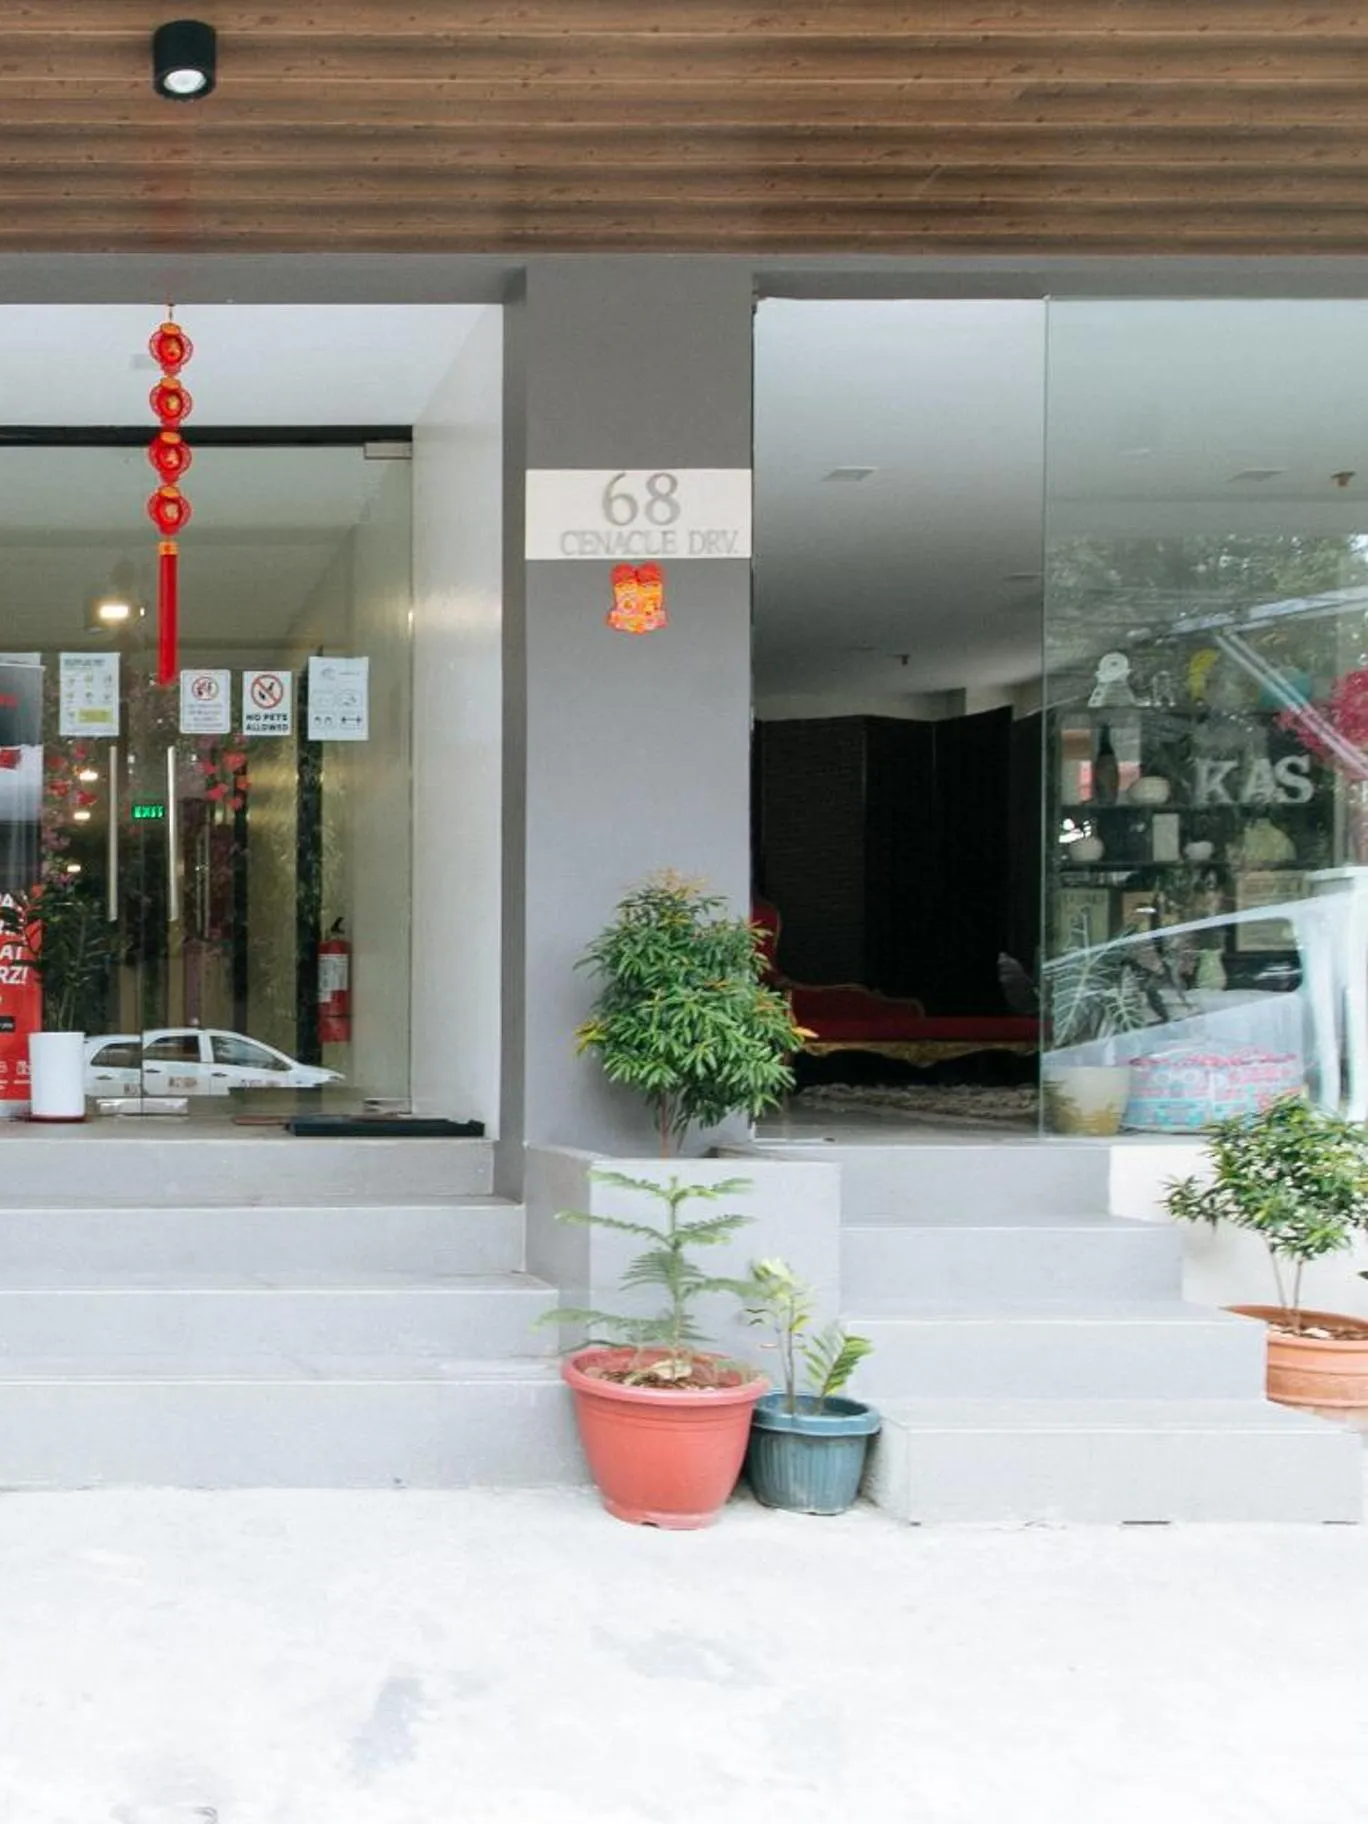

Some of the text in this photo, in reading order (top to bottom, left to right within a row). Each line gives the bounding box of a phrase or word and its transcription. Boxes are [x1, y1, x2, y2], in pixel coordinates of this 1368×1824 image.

[602, 472, 681, 526] 68
[560, 530, 677, 556] CENACLE
[246, 713, 288, 721] NO PETS
[246, 724, 289, 732] ALLOWED
